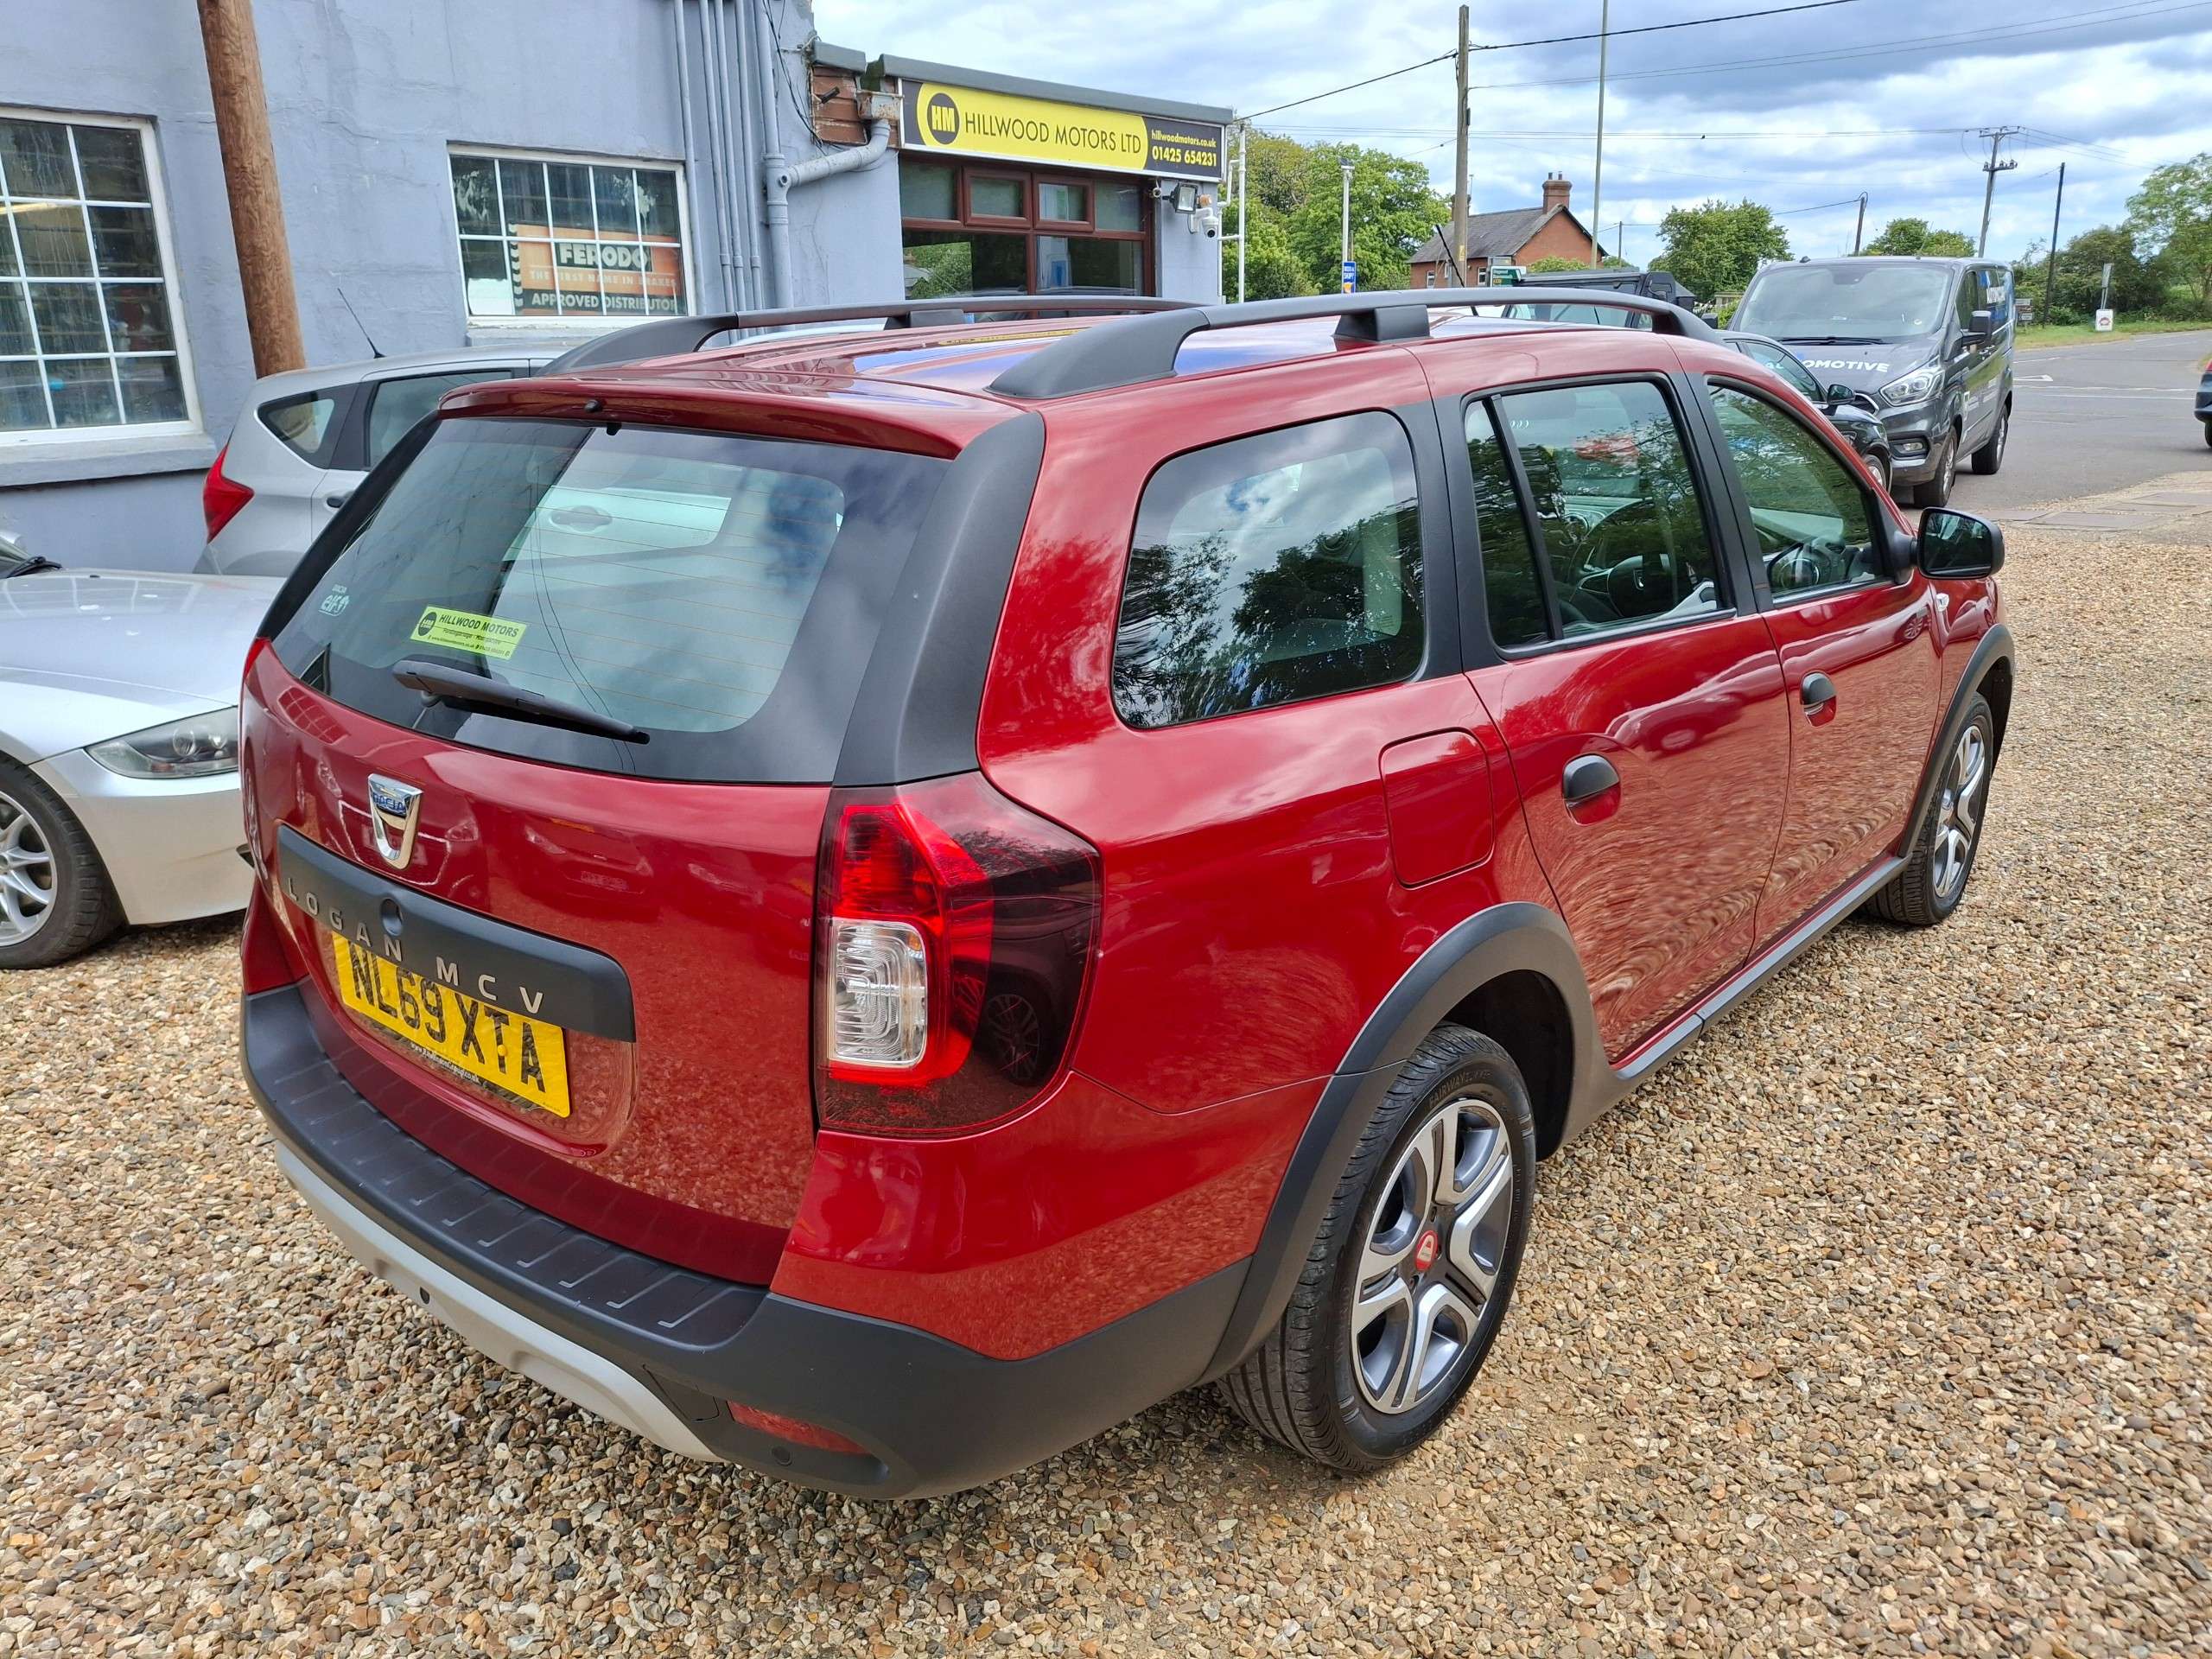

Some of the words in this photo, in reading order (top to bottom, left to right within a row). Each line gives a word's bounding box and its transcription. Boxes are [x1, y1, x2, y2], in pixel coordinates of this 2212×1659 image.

[931, 105, 956, 133] HM
[965, 111, 1049, 143] HILLWOOD
[1055, 124, 1116, 151] MOTORS
[1121, 132, 1141, 154] LTD
[1151, 129, 1217, 148] hillwoodmotors.co.uk
[1152, 145, 1182, 162] 01425
[1184, 149, 1217, 167] 654231
[559, 242, 648, 269] FERODO
[531, 292, 600, 308] APPROVED
[605, 297, 677, 312] DISTRIBUTOR
[1764, 359, 1890, 372] AUOMOTIVE
[439, 613, 480, 630] HILLWOOD
[481, 621, 518, 638] MOTORS
[287, 877, 403, 962] LOGAN
[435, 956, 544, 1014] MCV
[349, 939, 447, 1044] NL69
[454, 992, 546, 1093] XTA
